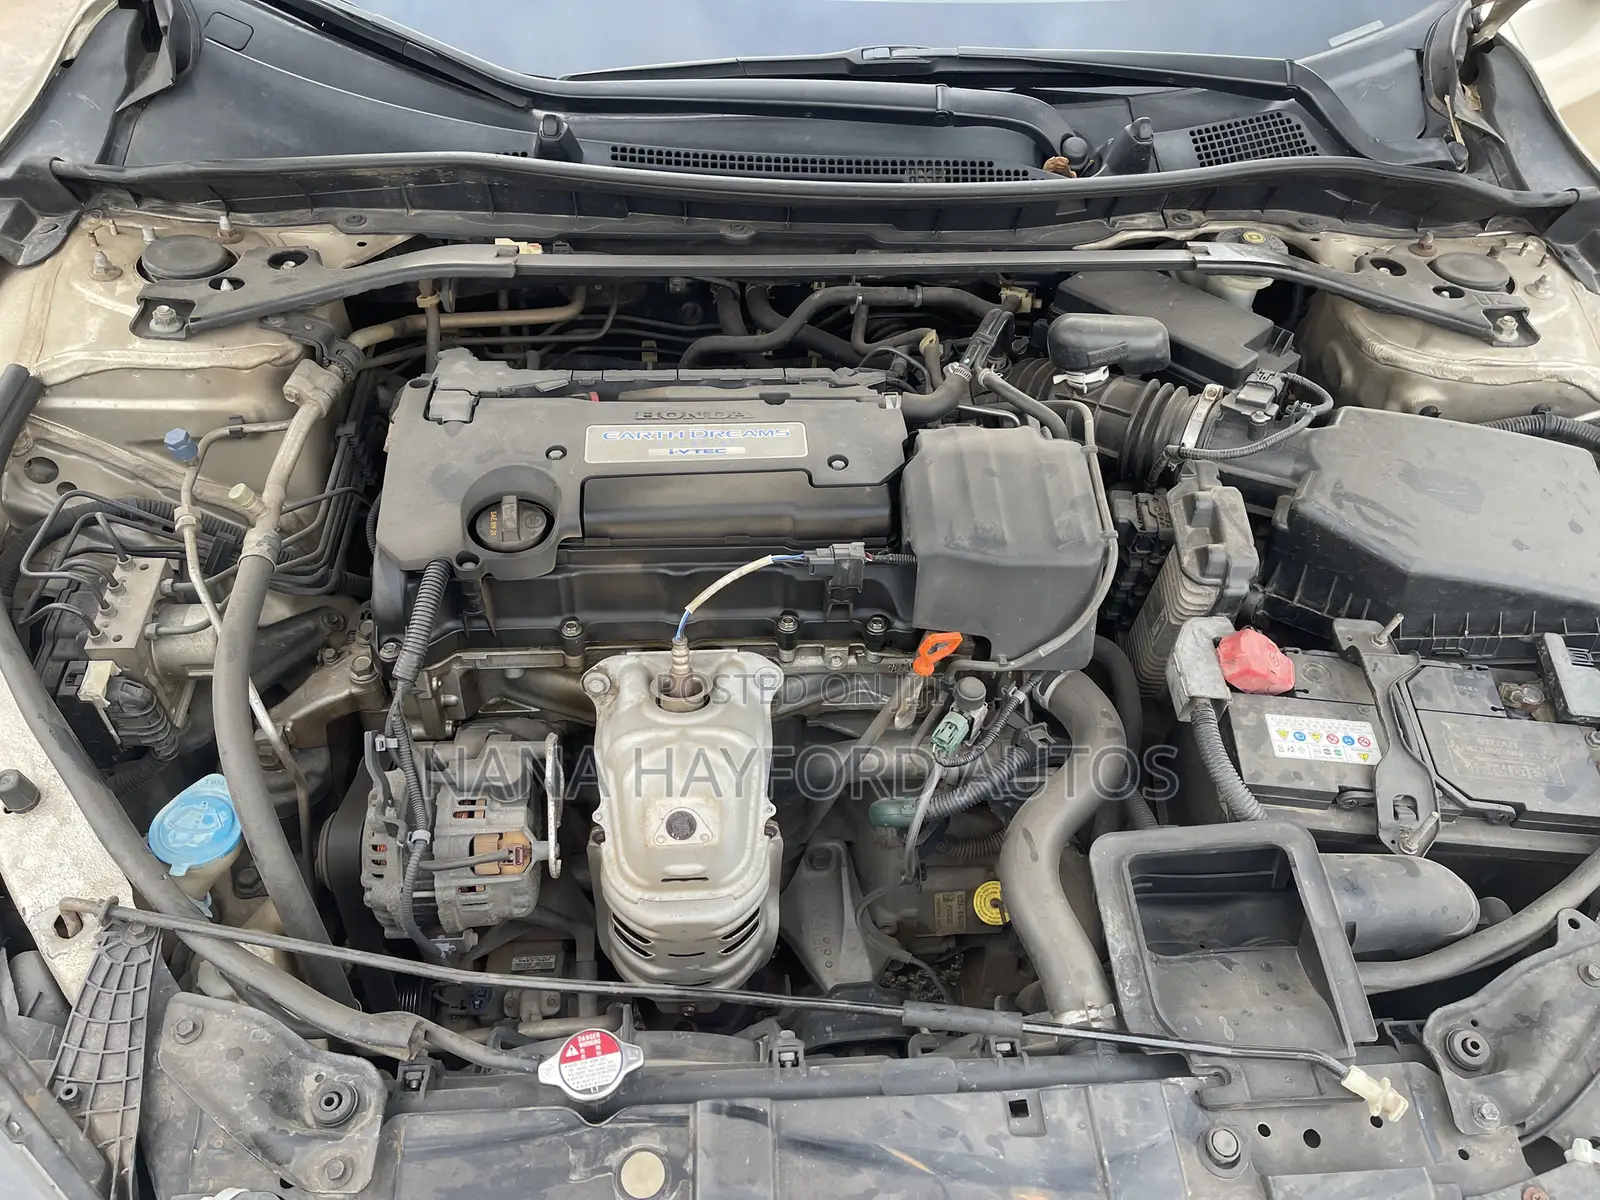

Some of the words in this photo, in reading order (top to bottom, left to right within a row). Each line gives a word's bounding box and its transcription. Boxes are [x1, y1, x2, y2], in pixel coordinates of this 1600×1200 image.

[634, 411, 755, 421] HONDA
[602, 429, 685, 441] EARTH
[689, 427, 791, 440] DREAMS
[577, 1032, 601, 1043] DANGER
